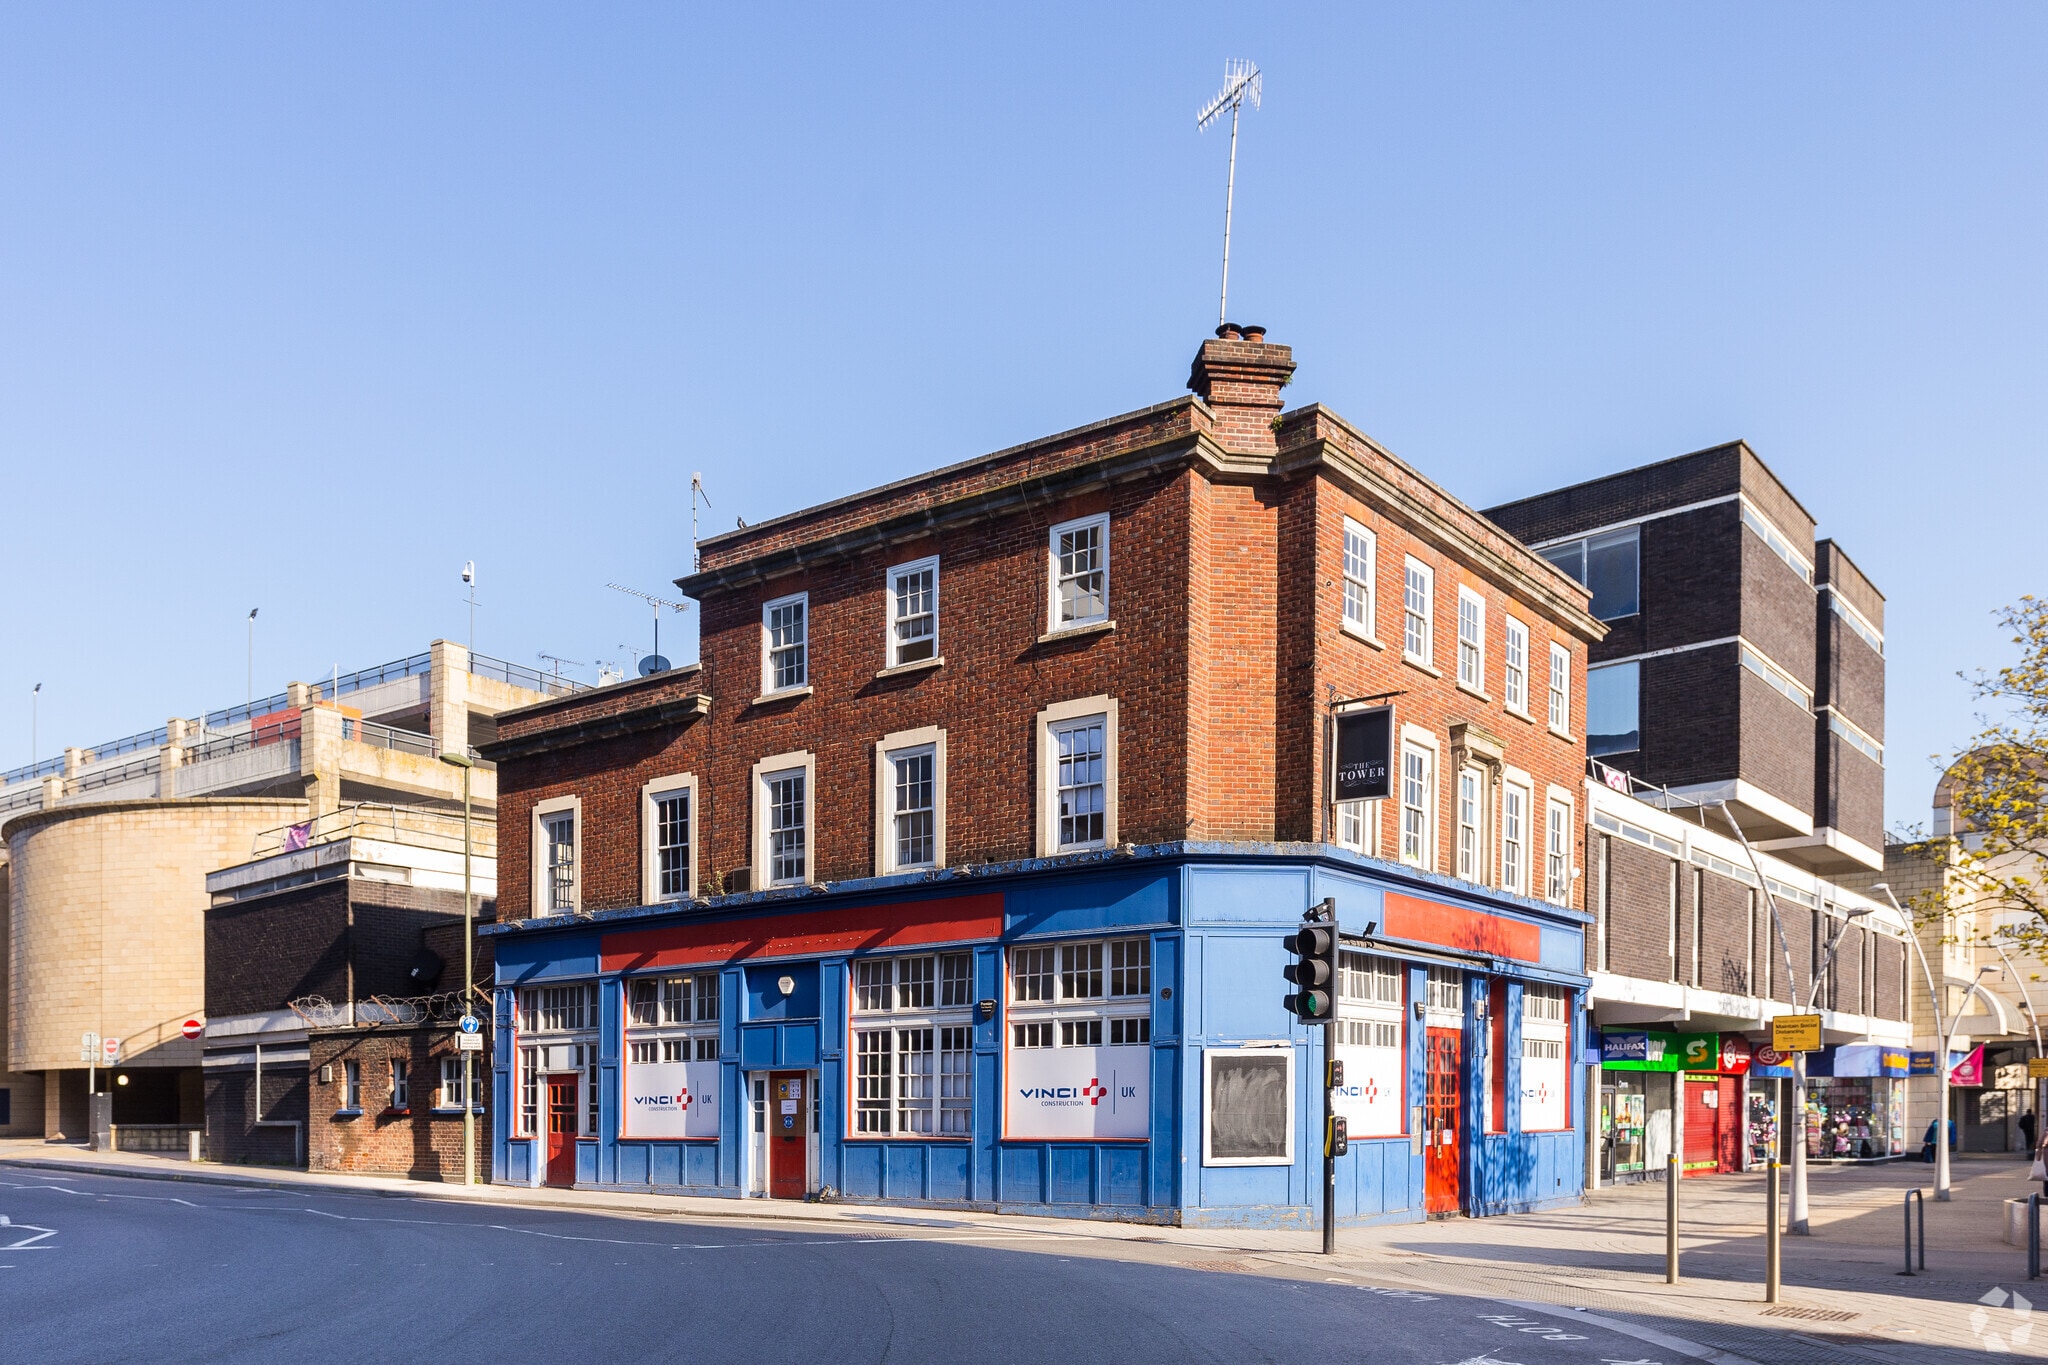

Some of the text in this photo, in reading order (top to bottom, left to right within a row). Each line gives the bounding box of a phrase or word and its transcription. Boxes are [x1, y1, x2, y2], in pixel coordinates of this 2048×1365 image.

[1354, 762, 1370, 770] THE
[1338, 767, 1385, 782] TOWER
[1604, 1042, 1646, 1052] HALIFAX
[1020, 1086, 1136, 1099] VINCI UK
[1335, 1086, 1363, 1097] INCI
[634, 1095, 712, 1104] VINCI UK
[1476, 1313, 1590, 1341] BOTH
